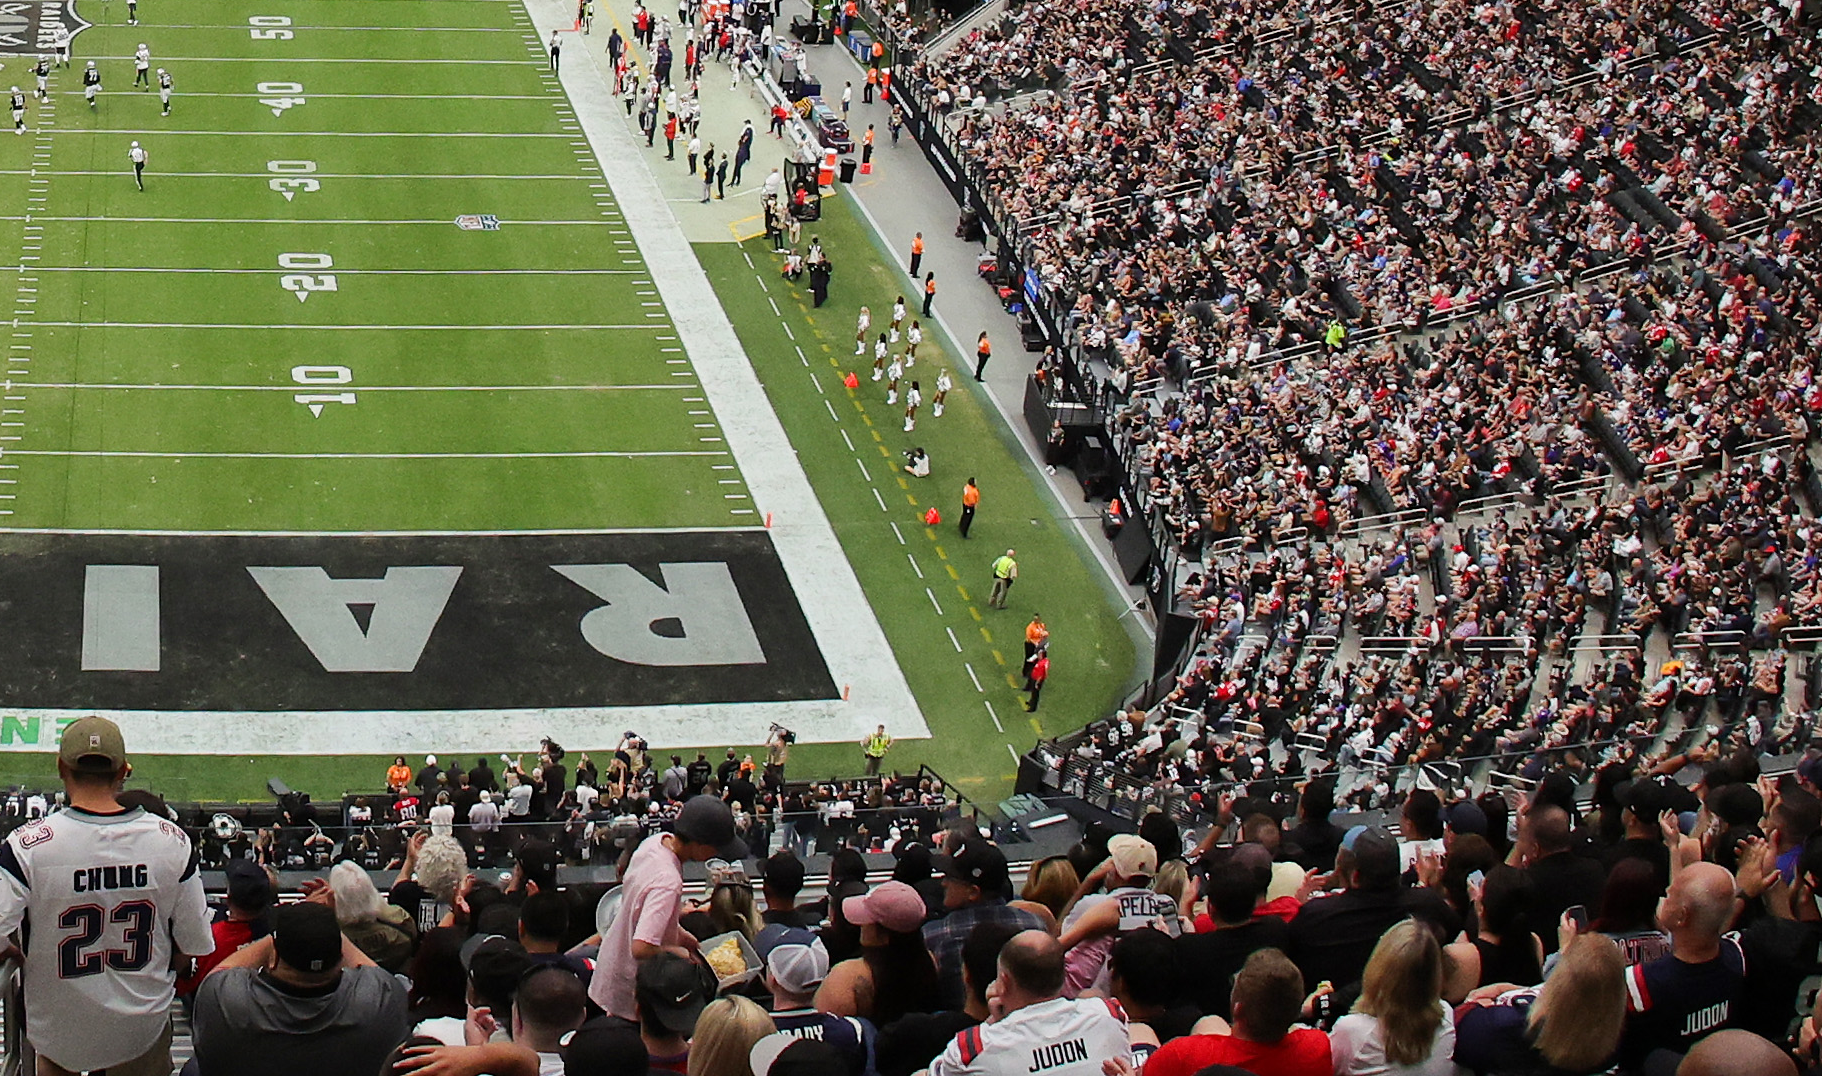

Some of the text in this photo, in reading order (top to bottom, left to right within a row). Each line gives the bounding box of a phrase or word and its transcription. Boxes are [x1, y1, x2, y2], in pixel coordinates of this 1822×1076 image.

[35, 1, 63, 49] RAIDERS
[248, 15, 294, 40] 50
[256, 81, 306, 109] 40
[266, 160, 321, 192] 30
[278, 252, 338, 291] 20
[291, 365, 357, 404] 10
[73, 864, 148, 892] CHUNG
[58, 899, 156, 979] 23
[1680, 999, 1729, 1036] JUDON
[1028, 1038, 1089, 1073] JUDON
